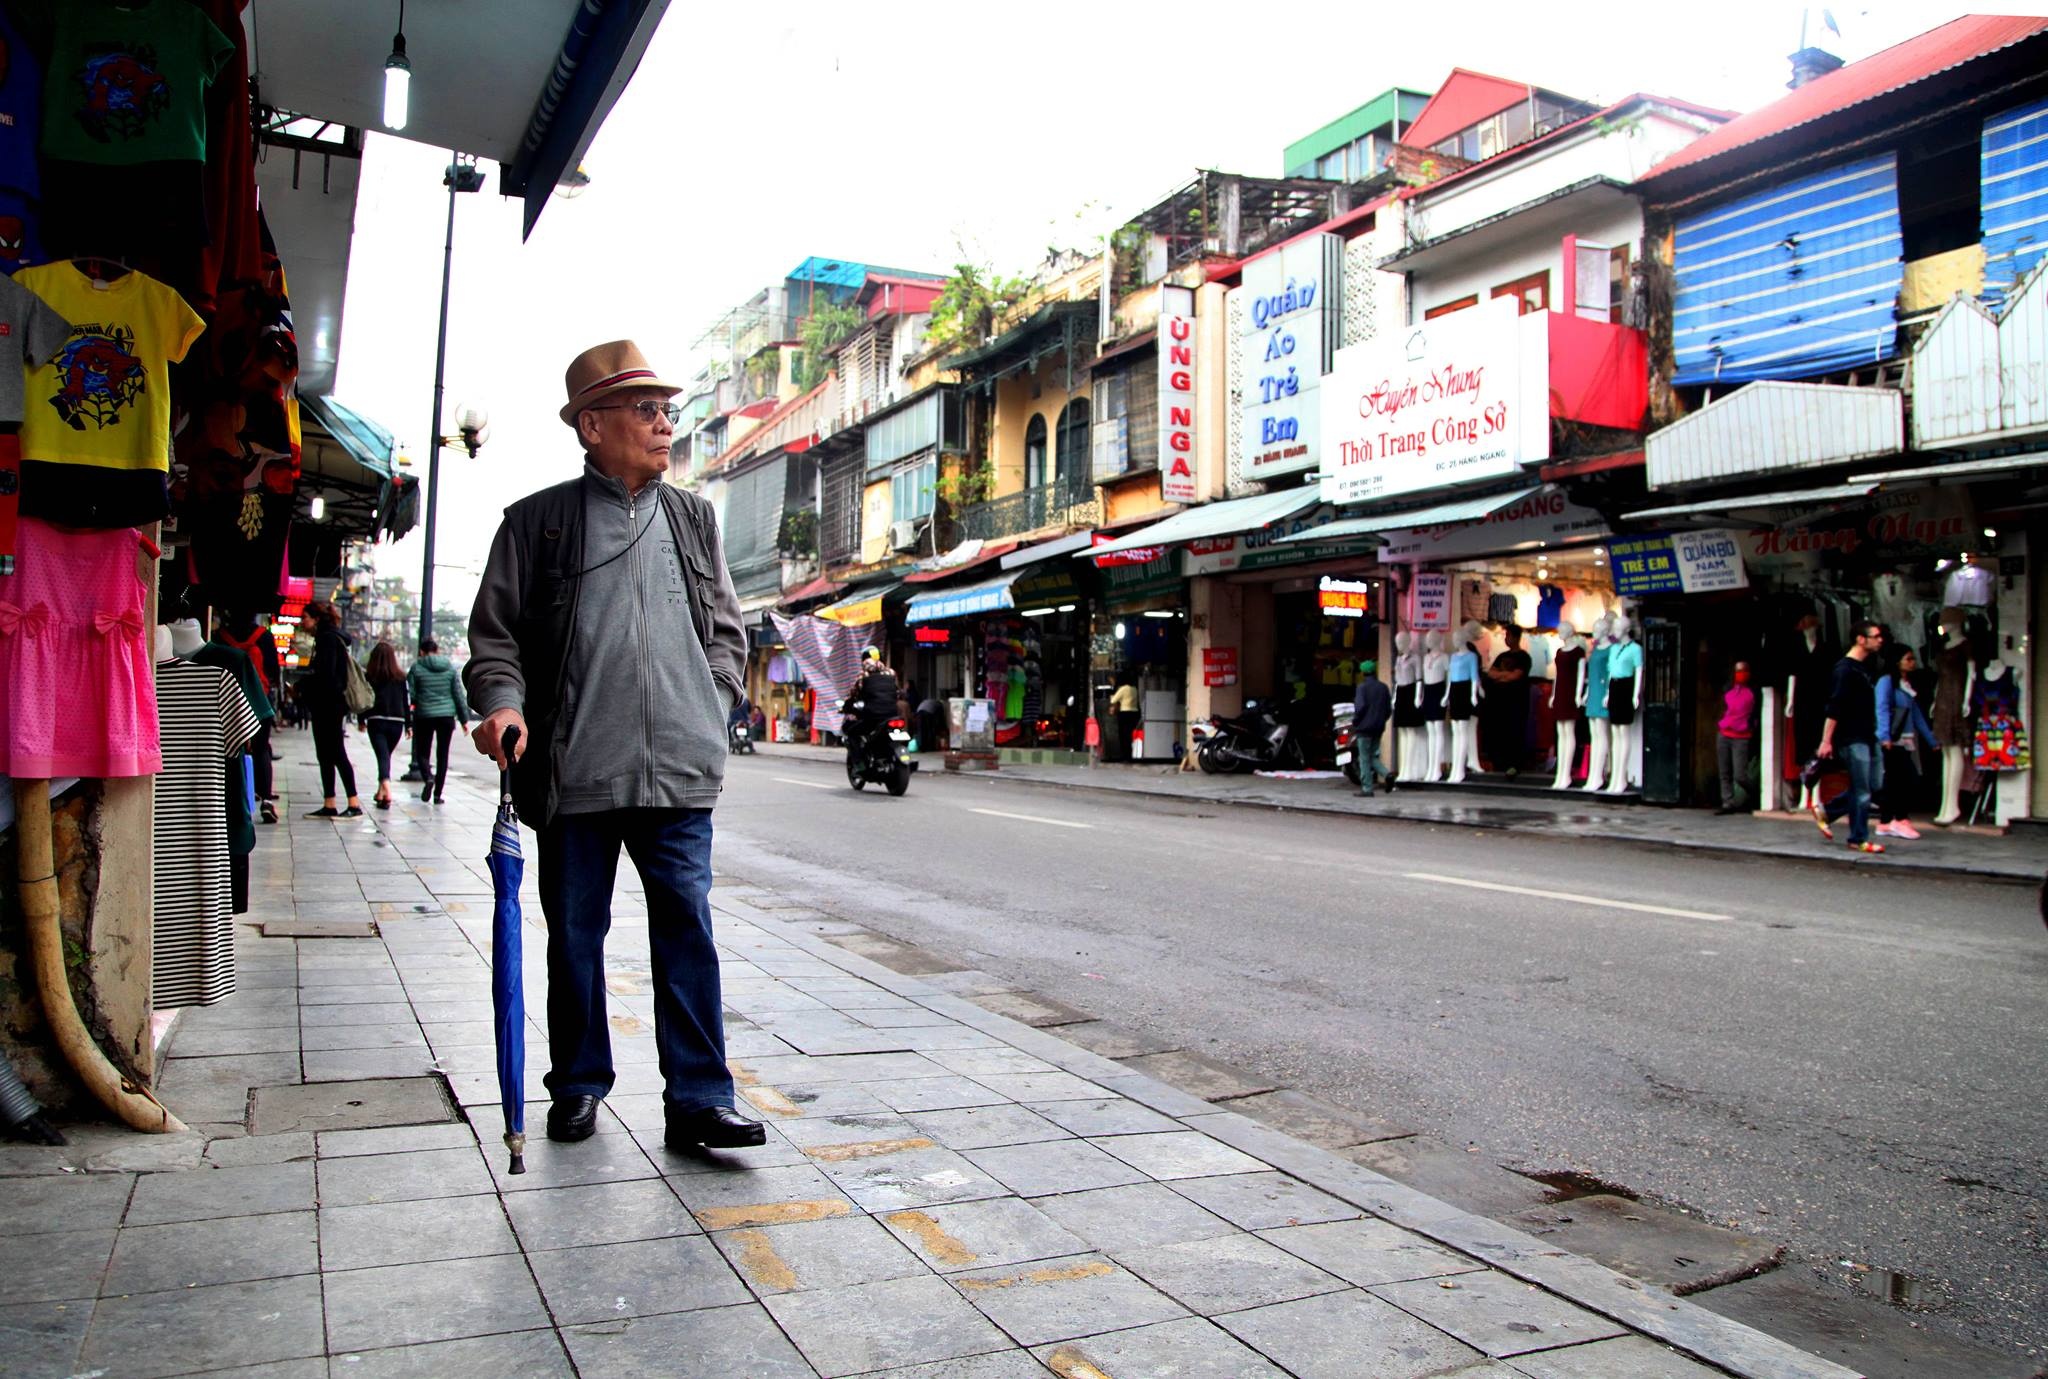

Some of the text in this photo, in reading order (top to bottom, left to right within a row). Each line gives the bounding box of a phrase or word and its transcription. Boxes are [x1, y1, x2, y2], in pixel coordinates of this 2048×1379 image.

[1252, 276, 1317, 330] Quần
[1264, 326, 1296, 362] Áo
[1259, 366, 1299, 404] Trẻ
[1422, 364, 1484, 404] Nhung
[1261, 416, 1299, 445] Em
[1339, 400, 1507, 466] Thời Trang Công Sở
[1648, 556, 1670, 570] EM
